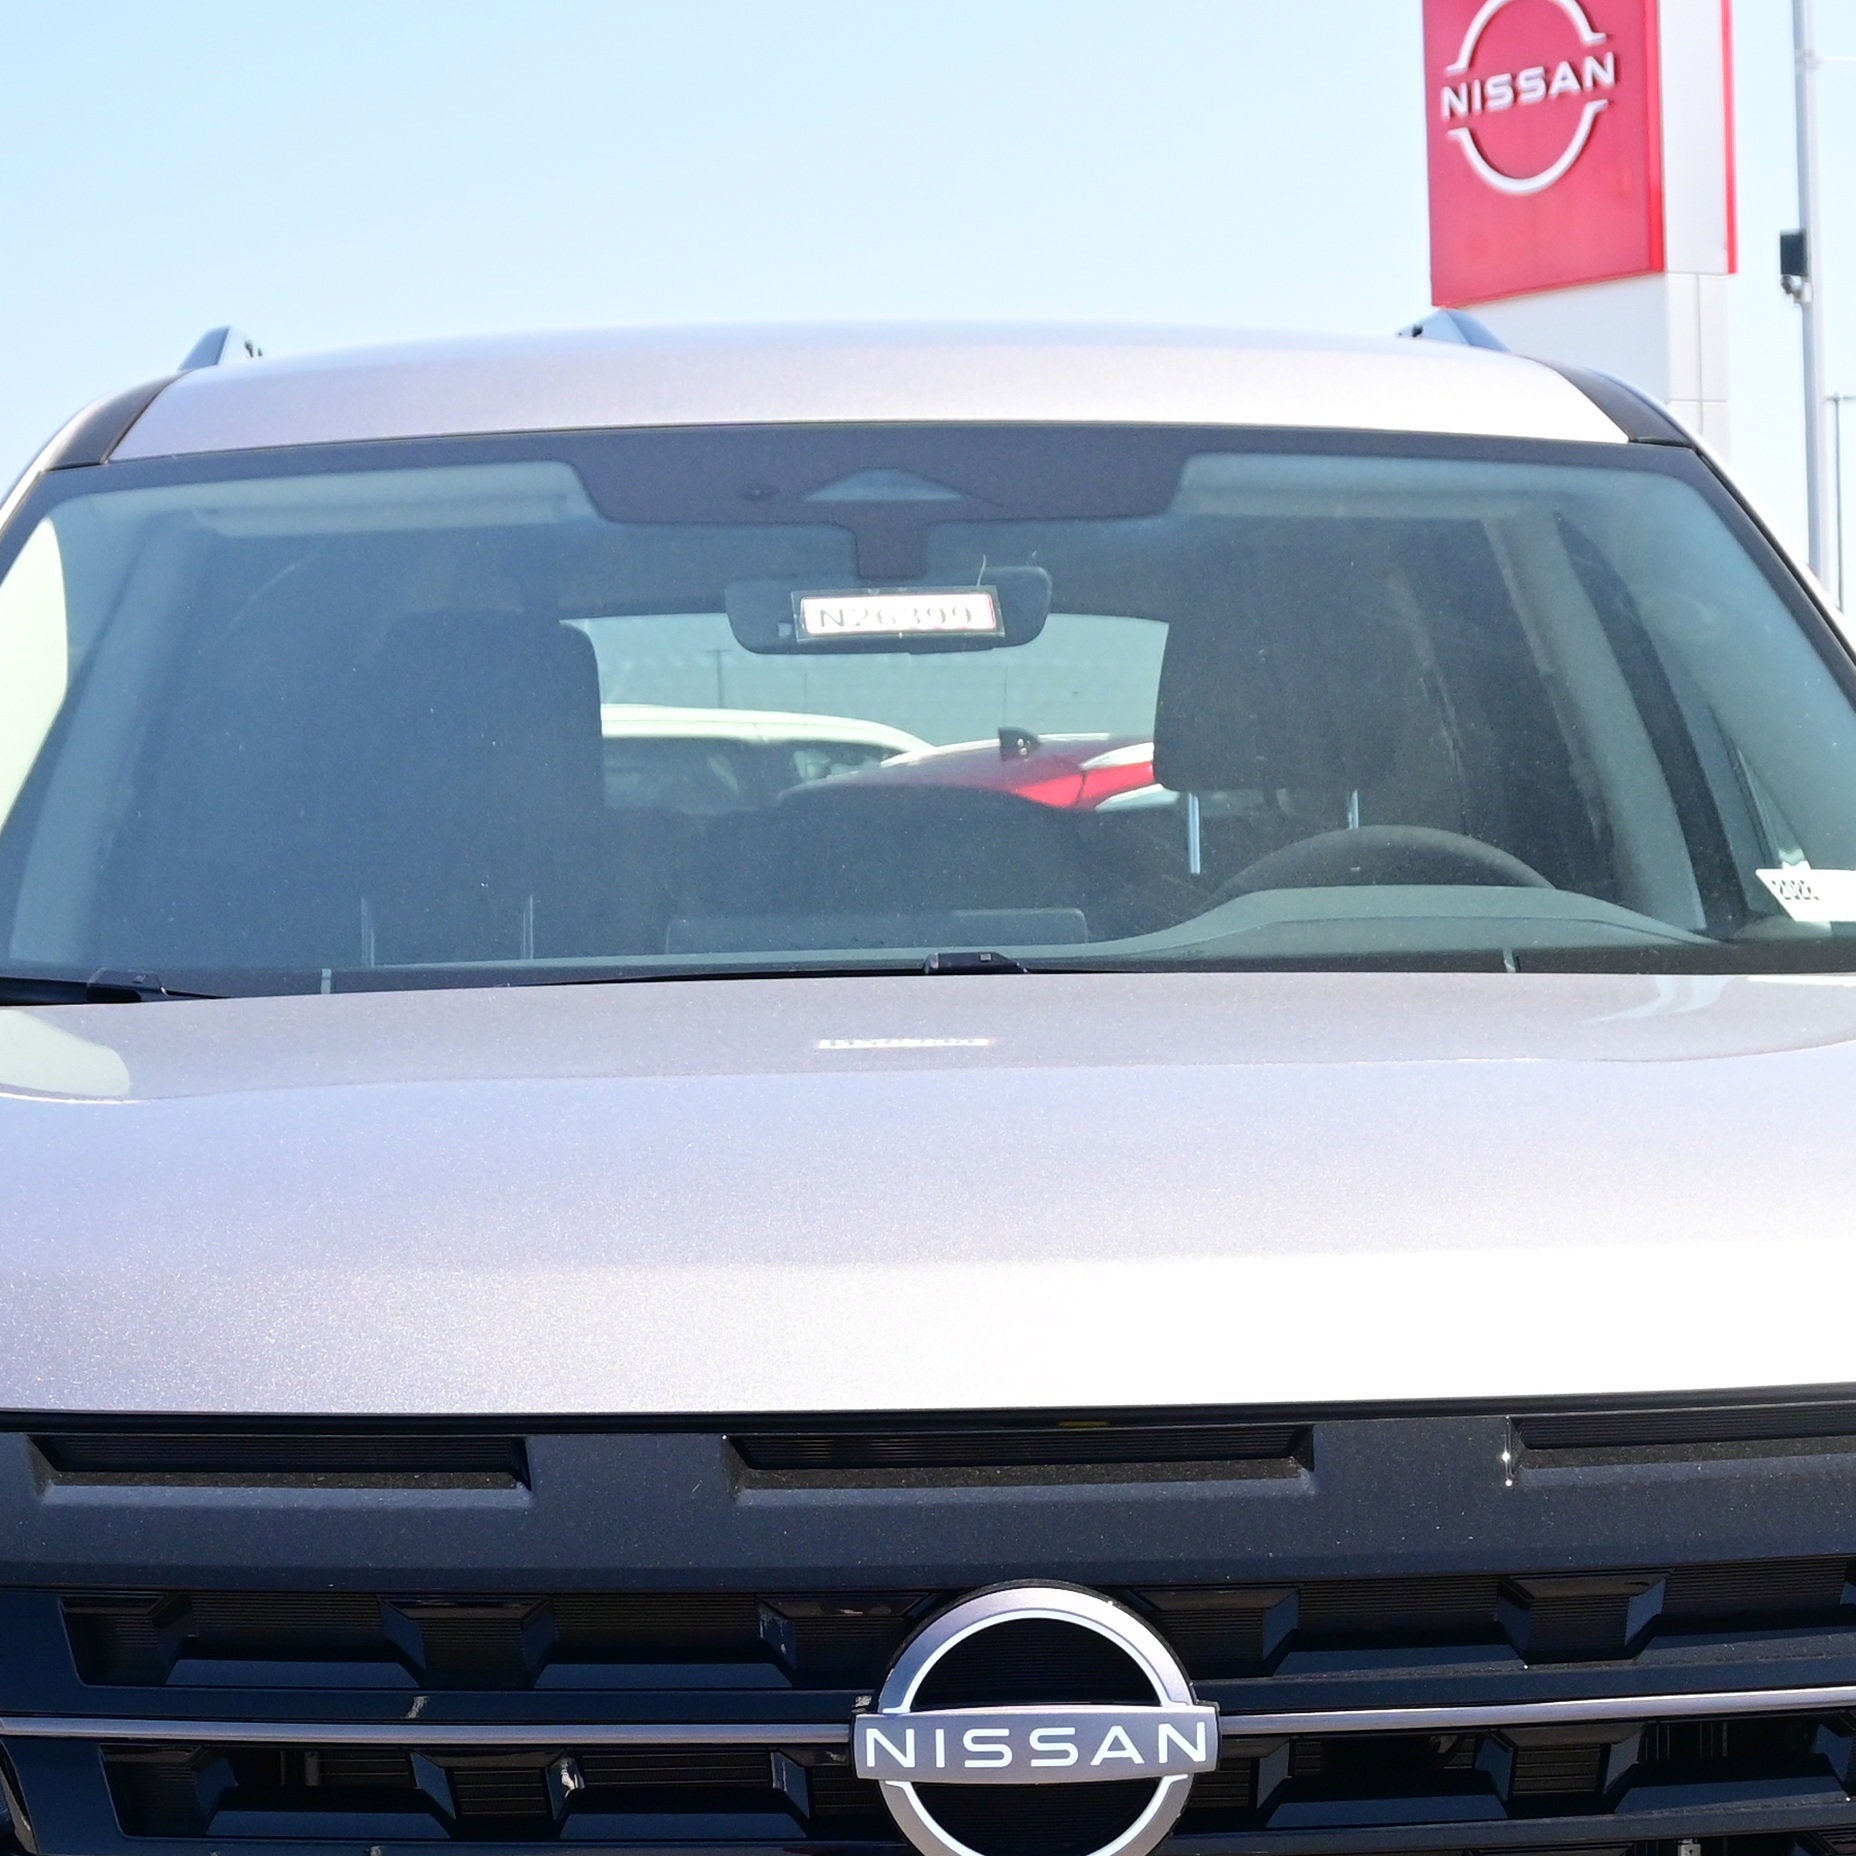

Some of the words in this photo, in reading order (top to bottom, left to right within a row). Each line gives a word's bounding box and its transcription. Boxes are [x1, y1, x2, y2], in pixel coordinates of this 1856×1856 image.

[1440, 51, 1616, 120] NISSAN
[818, 606, 973, 628] N26399
[865, 1721, 1208, 1769] NISSAN
